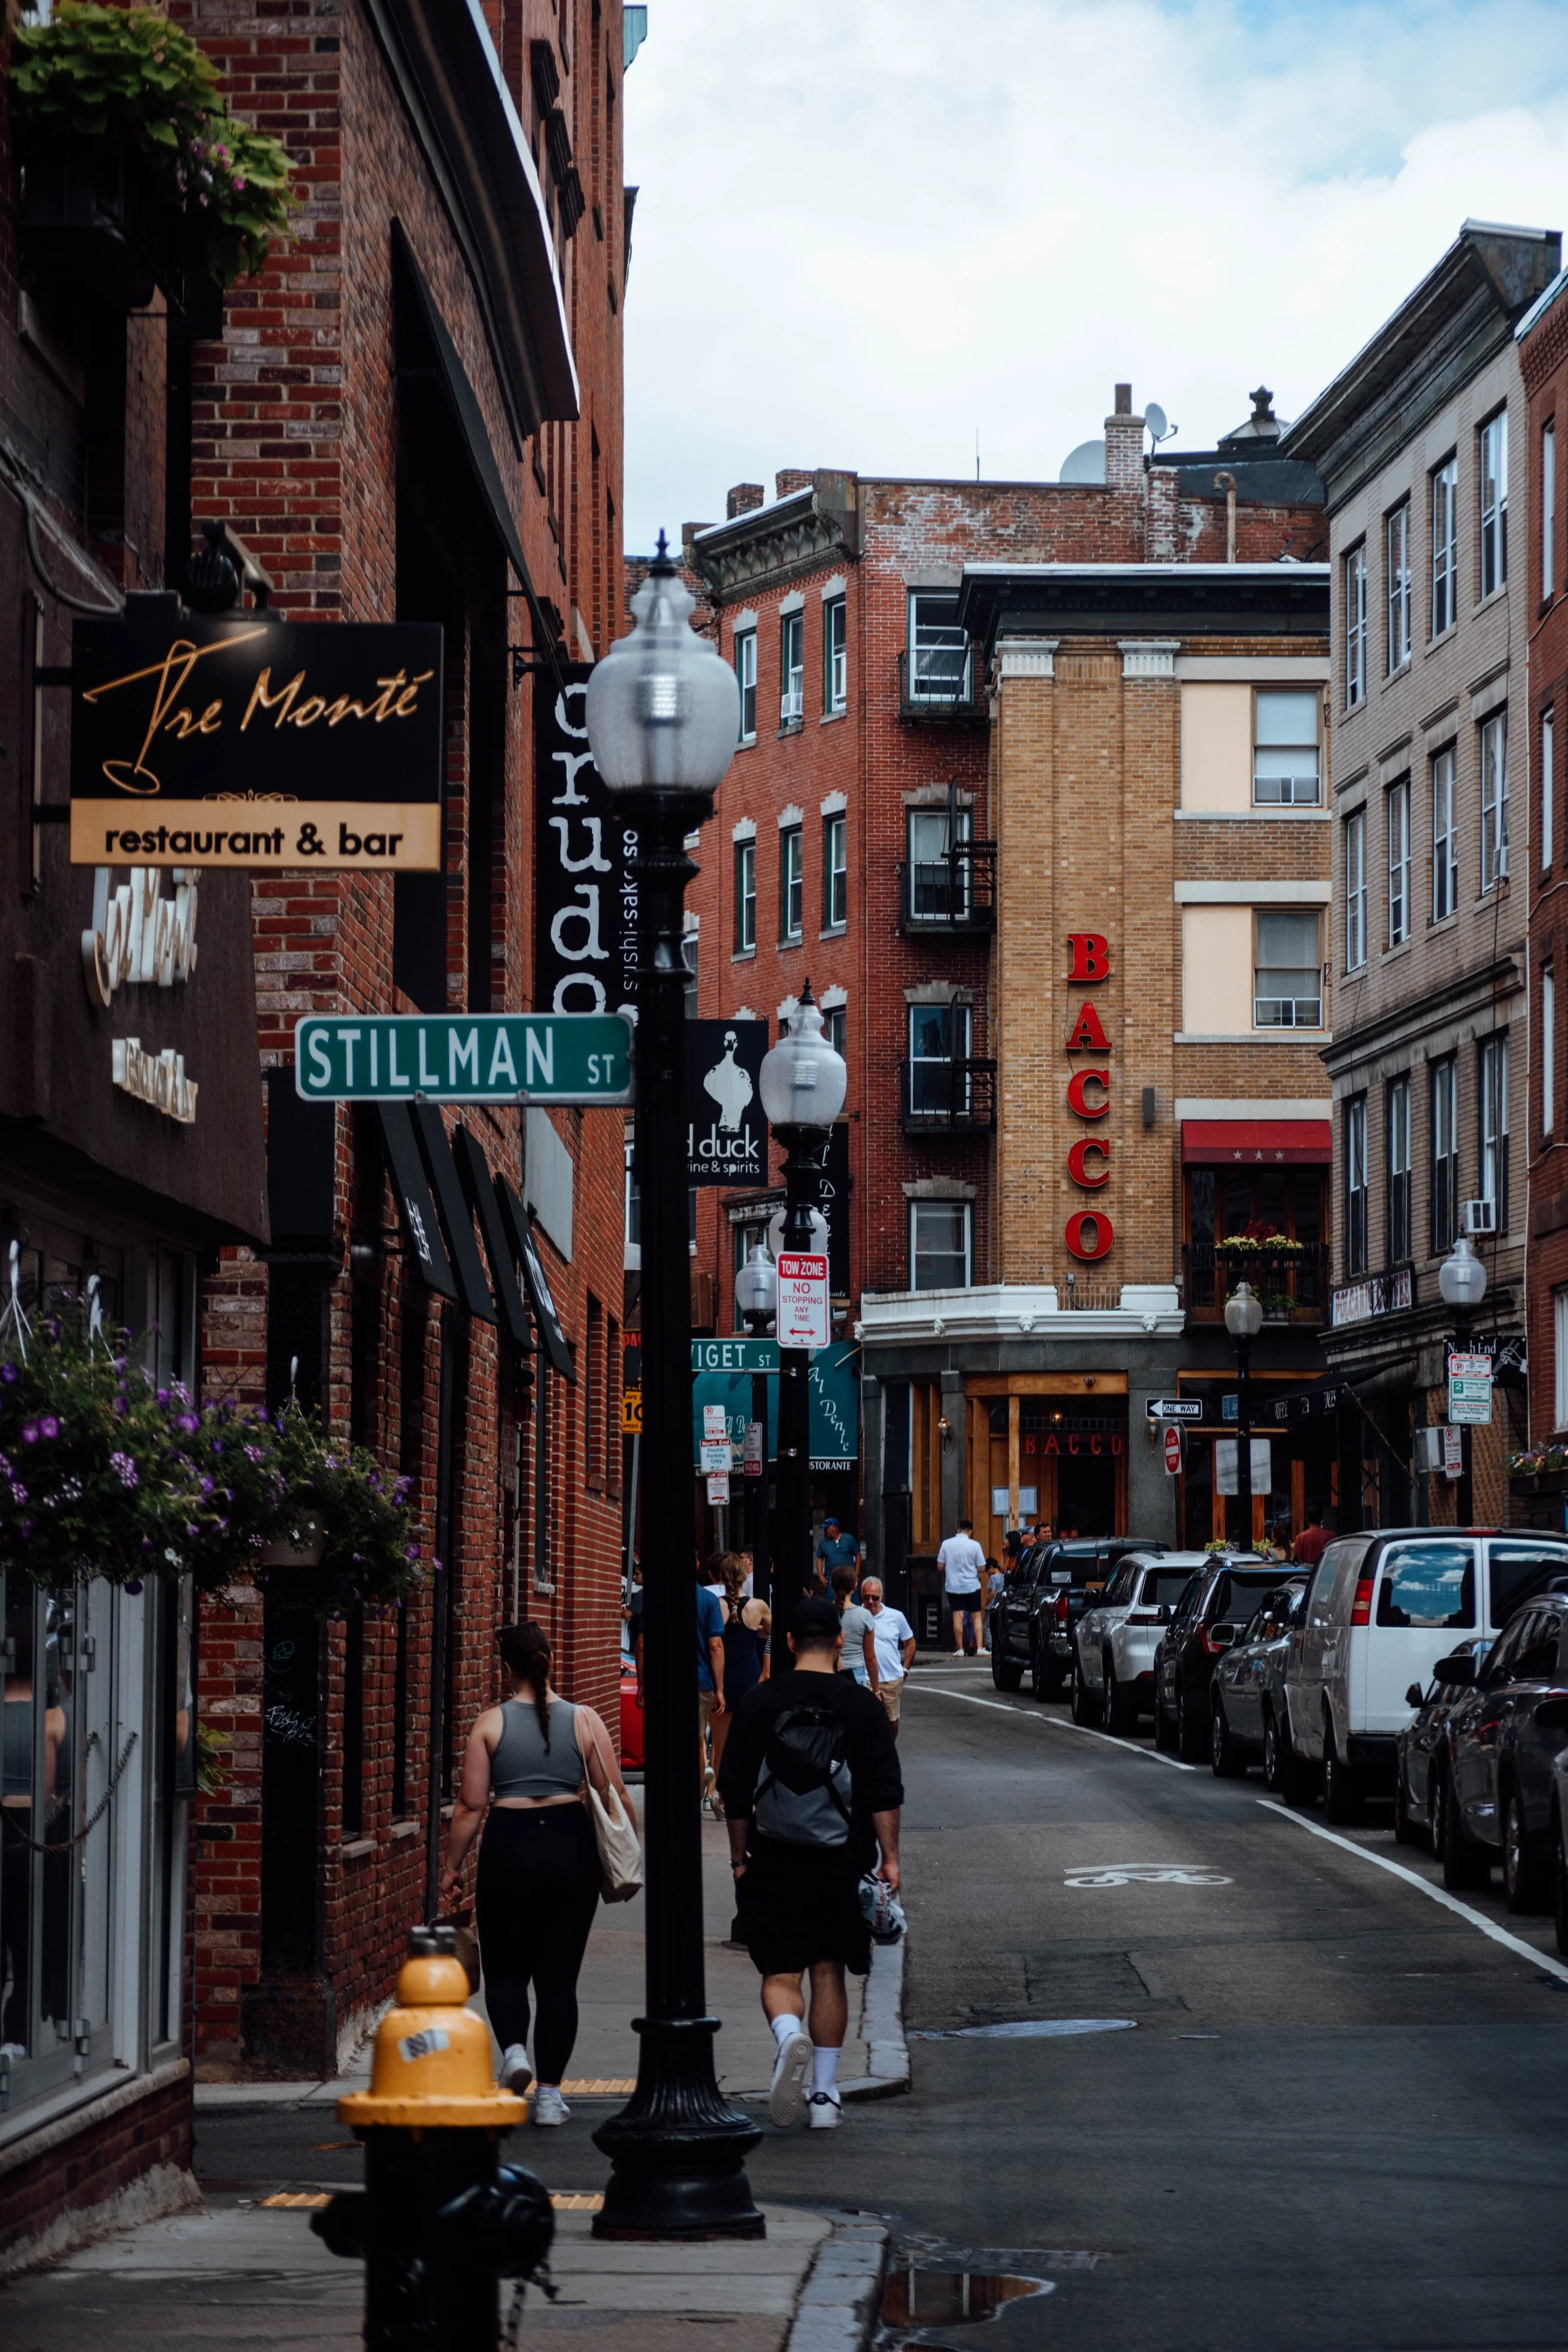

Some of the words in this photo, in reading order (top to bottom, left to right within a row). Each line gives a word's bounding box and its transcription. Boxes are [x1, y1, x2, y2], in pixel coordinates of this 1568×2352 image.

[82, 627, 267, 794] Tre
[240, 666, 435, 733] Monté
[105, 825, 285, 854] restaurant
[296, 822, 327, 856] &
[339, 822, 403, 856] bar
[307, 1026, 554, 1088] STILLMAN
[587, 1054, 615, 1084] ST
[1065, 933, 1114, 1260] BACCO
[699, 1123, 760, 1158] duck
[687, 1160, 709, 1172] ine
[711, 1160, 721, 1173] &
[723, 1160, 760, 1177] spirits
[781, 1260, 800, 1275] TOW
[800, 1261, 824, 1276] ZONE
[792, 1281, 811, 1294] NO
[782, 1295, 824, 1305] STOPPING
[793, 1314, 810, 1322] TIME
[691, 1343, 746, 1367] IGET
[758, 1355, 771, 1367] ST
[1162, 1404, 1177, 1412] ONE
[1180, 1404, 1196, 1412] WAY
[1025, 1434, 1123, 1455] BACCO
[808, 1460, 851, 1471] ISTORANTE
